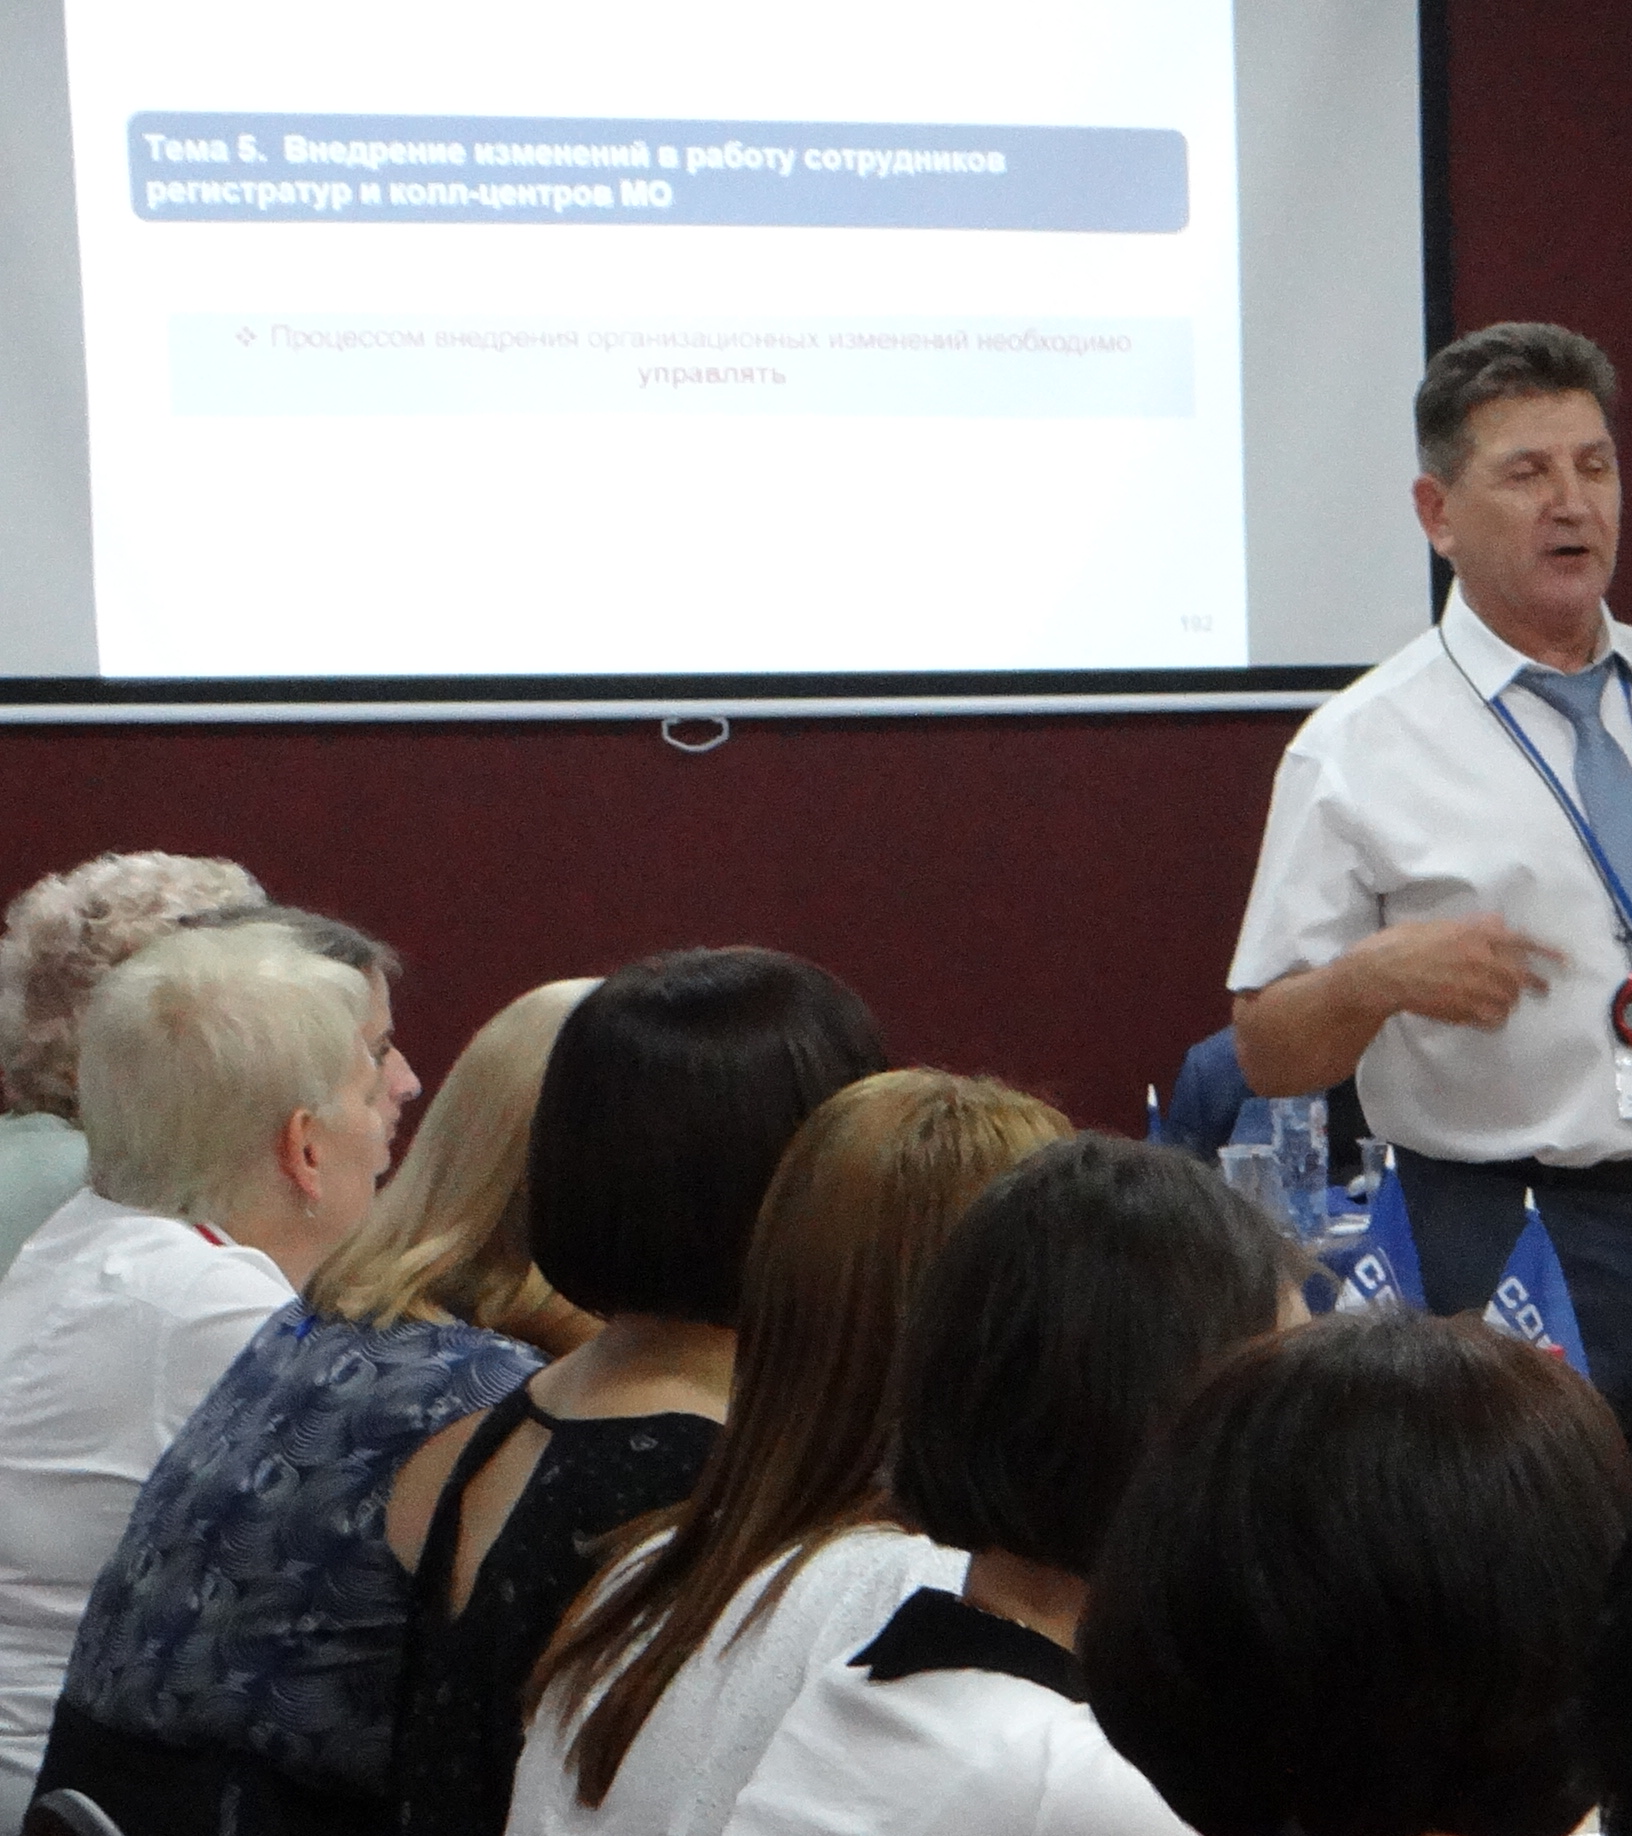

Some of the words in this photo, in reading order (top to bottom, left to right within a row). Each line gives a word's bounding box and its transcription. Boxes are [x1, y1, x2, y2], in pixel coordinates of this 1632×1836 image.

[142, 133, 230, 163] Тема
[283, 134, 467, 170] Внедрение
[473, 140, 650, 168] изменений
[658, 146, 679, 169] в
[686, 141, 796, 177] работу
[803, 148, 1007, 178] сотрудников
[145, 180, 352, 211] регистратур
[359, 181, 382, 205] и
[388, 182, 614, 213] колл-центров
[619, 178, 675, 209] МО
[270, 323, 426, 353] Процессом
[434, 328, 580, 354] внедрения
[587, 330, 821, 353] организационных
[828, 329, 970, 352] изменений
[976, 326, 1133, 357] необходимо
[636, 366, 787, 389] управлять
